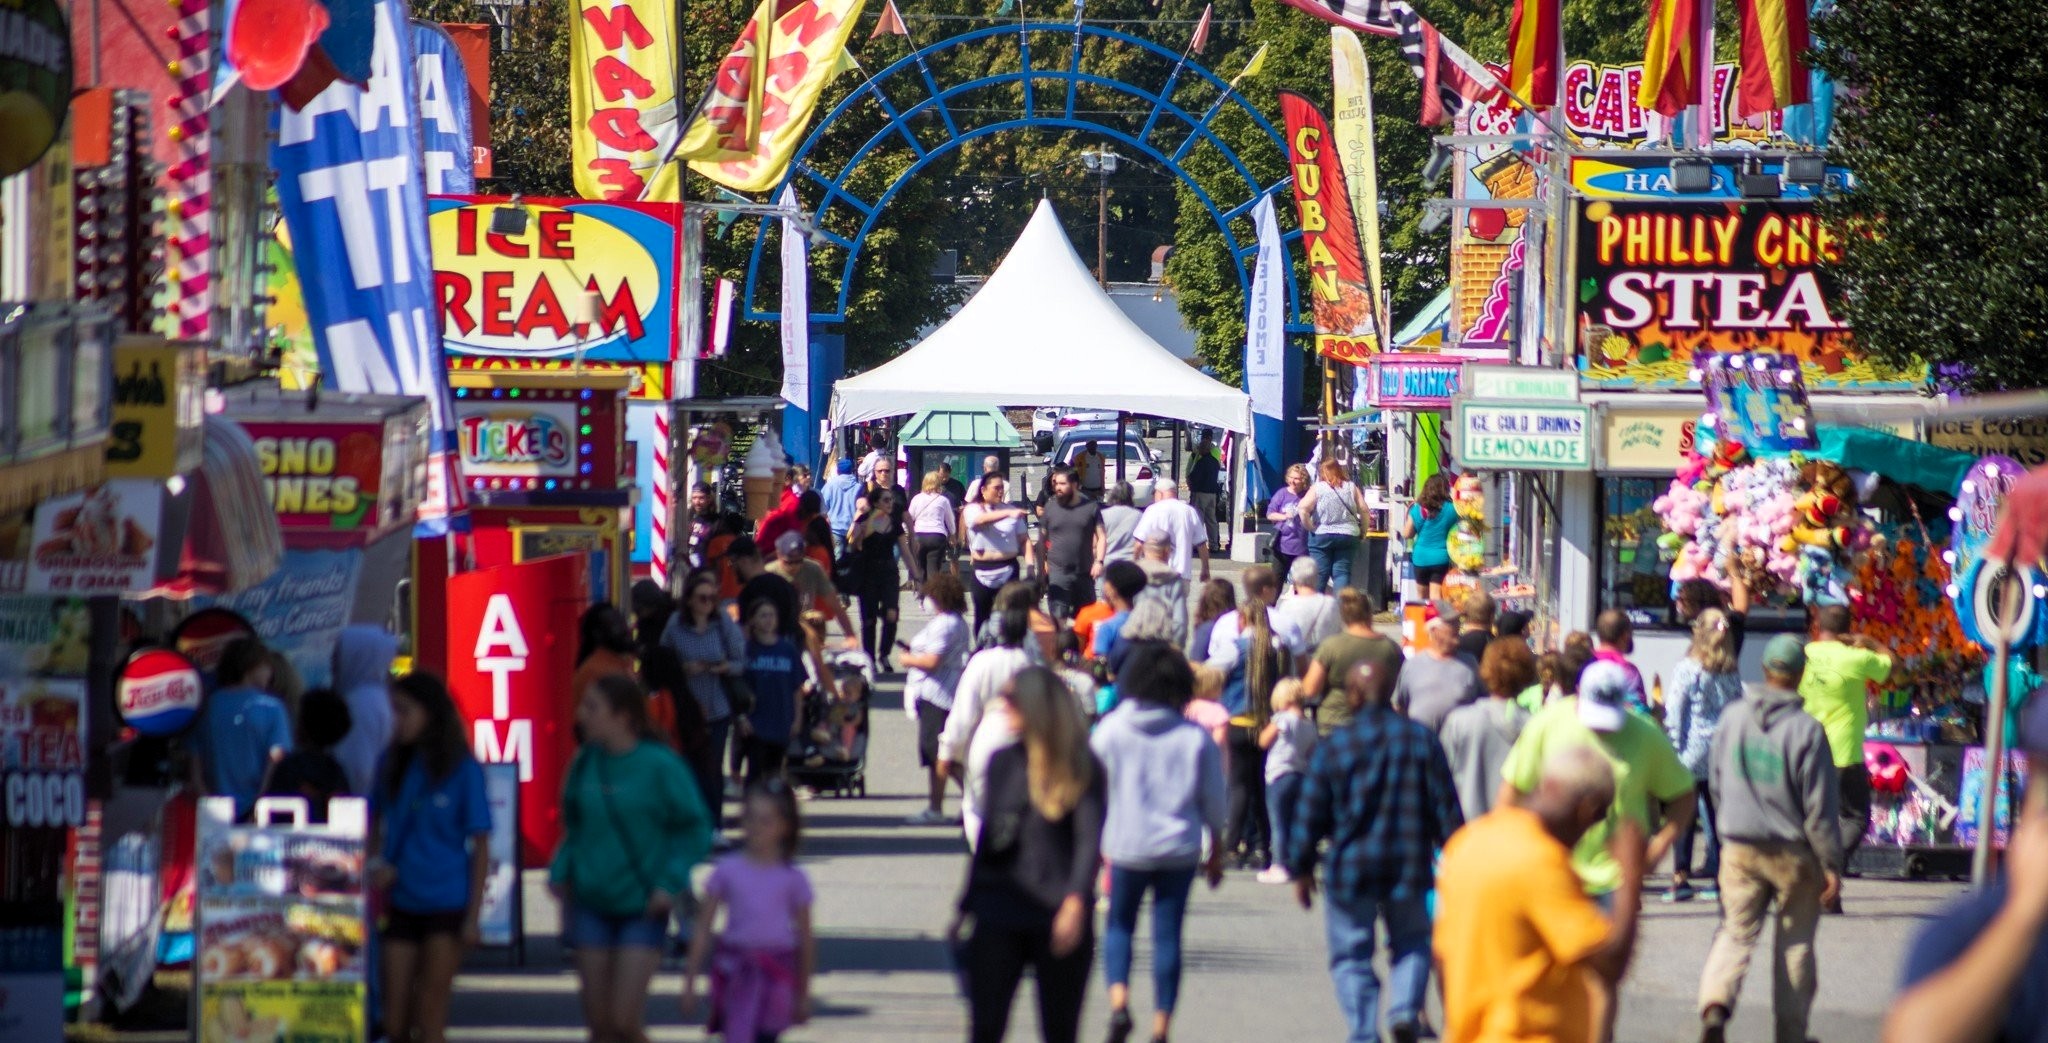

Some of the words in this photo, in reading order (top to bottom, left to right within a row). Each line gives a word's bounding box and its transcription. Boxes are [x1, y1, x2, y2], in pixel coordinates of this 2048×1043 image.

[457, 208, 575, 261] ICE
[1296, 127, 1341, 302] CUBAN
[1599, 213, 1741, 265] PHILLY
[434, 270, 647, 343] REAM
[1603, 271, 1850, 329] STEA
[1402, 366, 1460, 398] DRINKS
[1496, 381, 1570, 396] LEMONADE
[463, 416, 565, 461] TICKETS
[1470, 414, 1491, 431] ICE
[1498, 415, 1528, 431] COLD
[1536, 415, 1582, 432] DRINKS
[1935, 419, 1974, 435] ICE
[256, 437, 337, 475] SNO
[1471, 437, 1580, 460] LEMONADE
[474, 593, 534, 783] ATM
